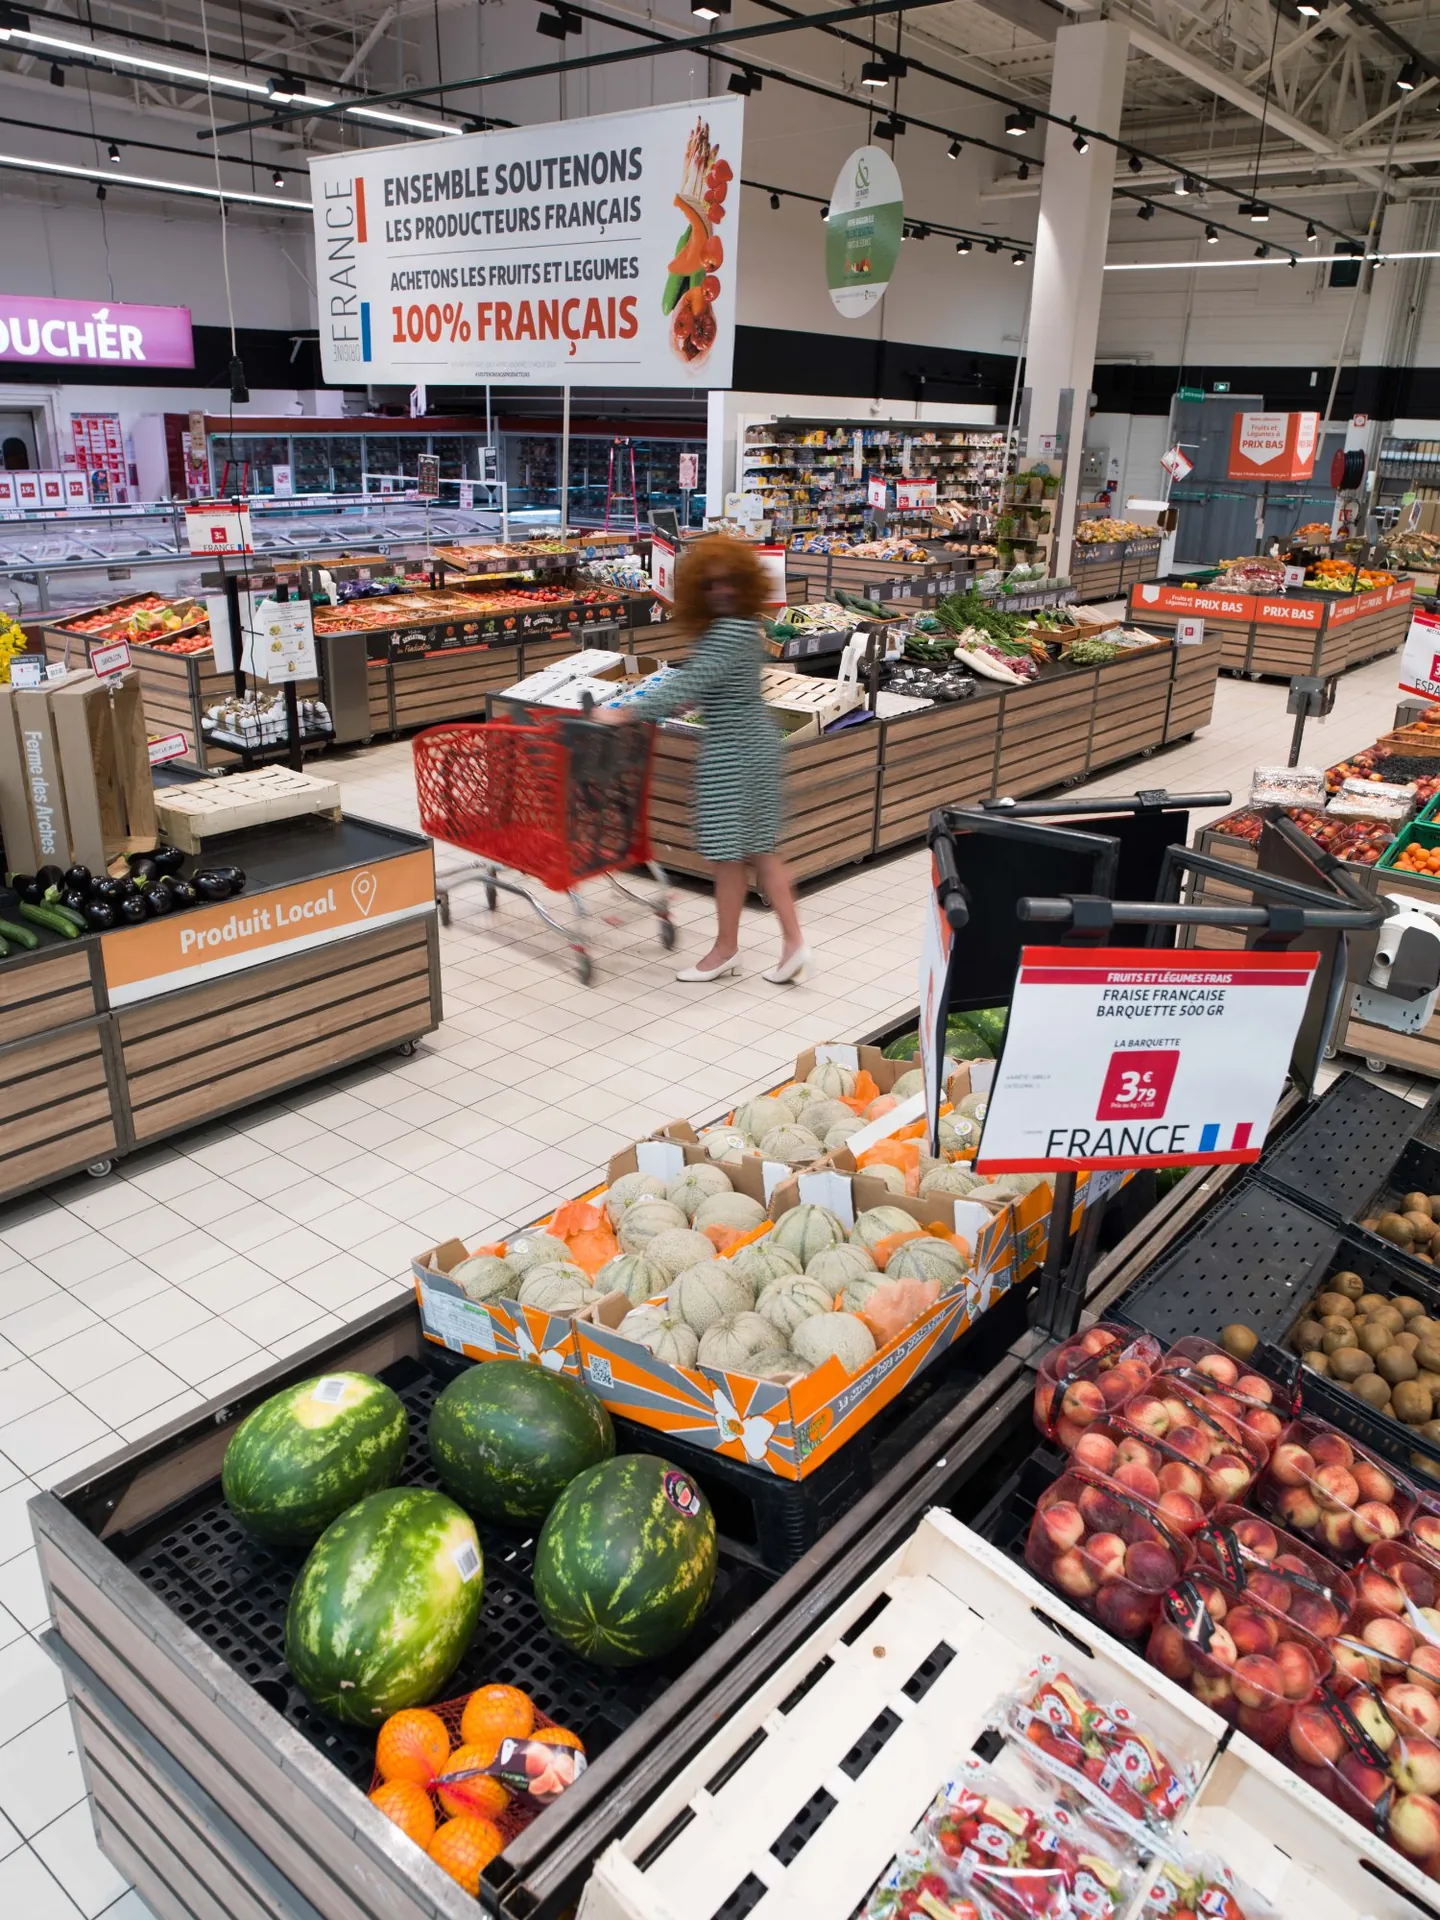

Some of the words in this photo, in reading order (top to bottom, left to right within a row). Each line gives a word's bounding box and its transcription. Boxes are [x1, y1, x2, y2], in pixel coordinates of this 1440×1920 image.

[384, 165, 489, 207] ENSEMBLE
[495, 146, 643, 195] SOUTENONS
[385, 218, 412, 243] LES
[415, 205, 541, 240] PRODUCTEURS
[544, 195, 642, 235] FRANÇAIS
[324, 179, 358, 342] FRANCE
[390, 267, 458, 291] ACHETONS
[461, 266, 487, 286] LES
[489, 262, 541, 286] FRUITS
[543, 261, 563, 283] ET
[565, 256, 640, 282] LEGUMES
[0, 317, 147, 361] UCHER
[392, 301, 471, 343] 100%
[477, 295, 639, 356] FRANÇAIS
[1242, 440, 1262, 448] PRIX
[1266, 440, 1284, 448] BAS
[203, 544, 235, 552] FRANCE
[1194, 598, 1219, 610] PRIX
[1221, 602, 1243, 612] BAS
[1263, 606, 1289, 616] PRIX
[1292, 608, 1314, 620] BAS
[25, 731, 43, 773] Ferme
[31, 776, 49, 803] des
[36, 807, 56, 854] Arches
[180, 909, 271, 954] Produit
[276, 888, 337, 927] Local
[1107, 972, 1143, 982] FRUITS
[1145, 973, 1158, 982] ET
[1158, 972, 1203, 983] LÉGUMES
[1204, 974, 1232, 983] FRAIS
[1096, 1005, 1177, 1018] BARQUETTE
[1179, 1005, 1204, 1016] 500
[1206, 1004, 1224, 1016] GR
[1103, 990, 1150, 1001] FRAISE
[1128, 1038, 1181, 1048] BARQUETTE
[1045, 1125, 1190, 1158] FRANCE
